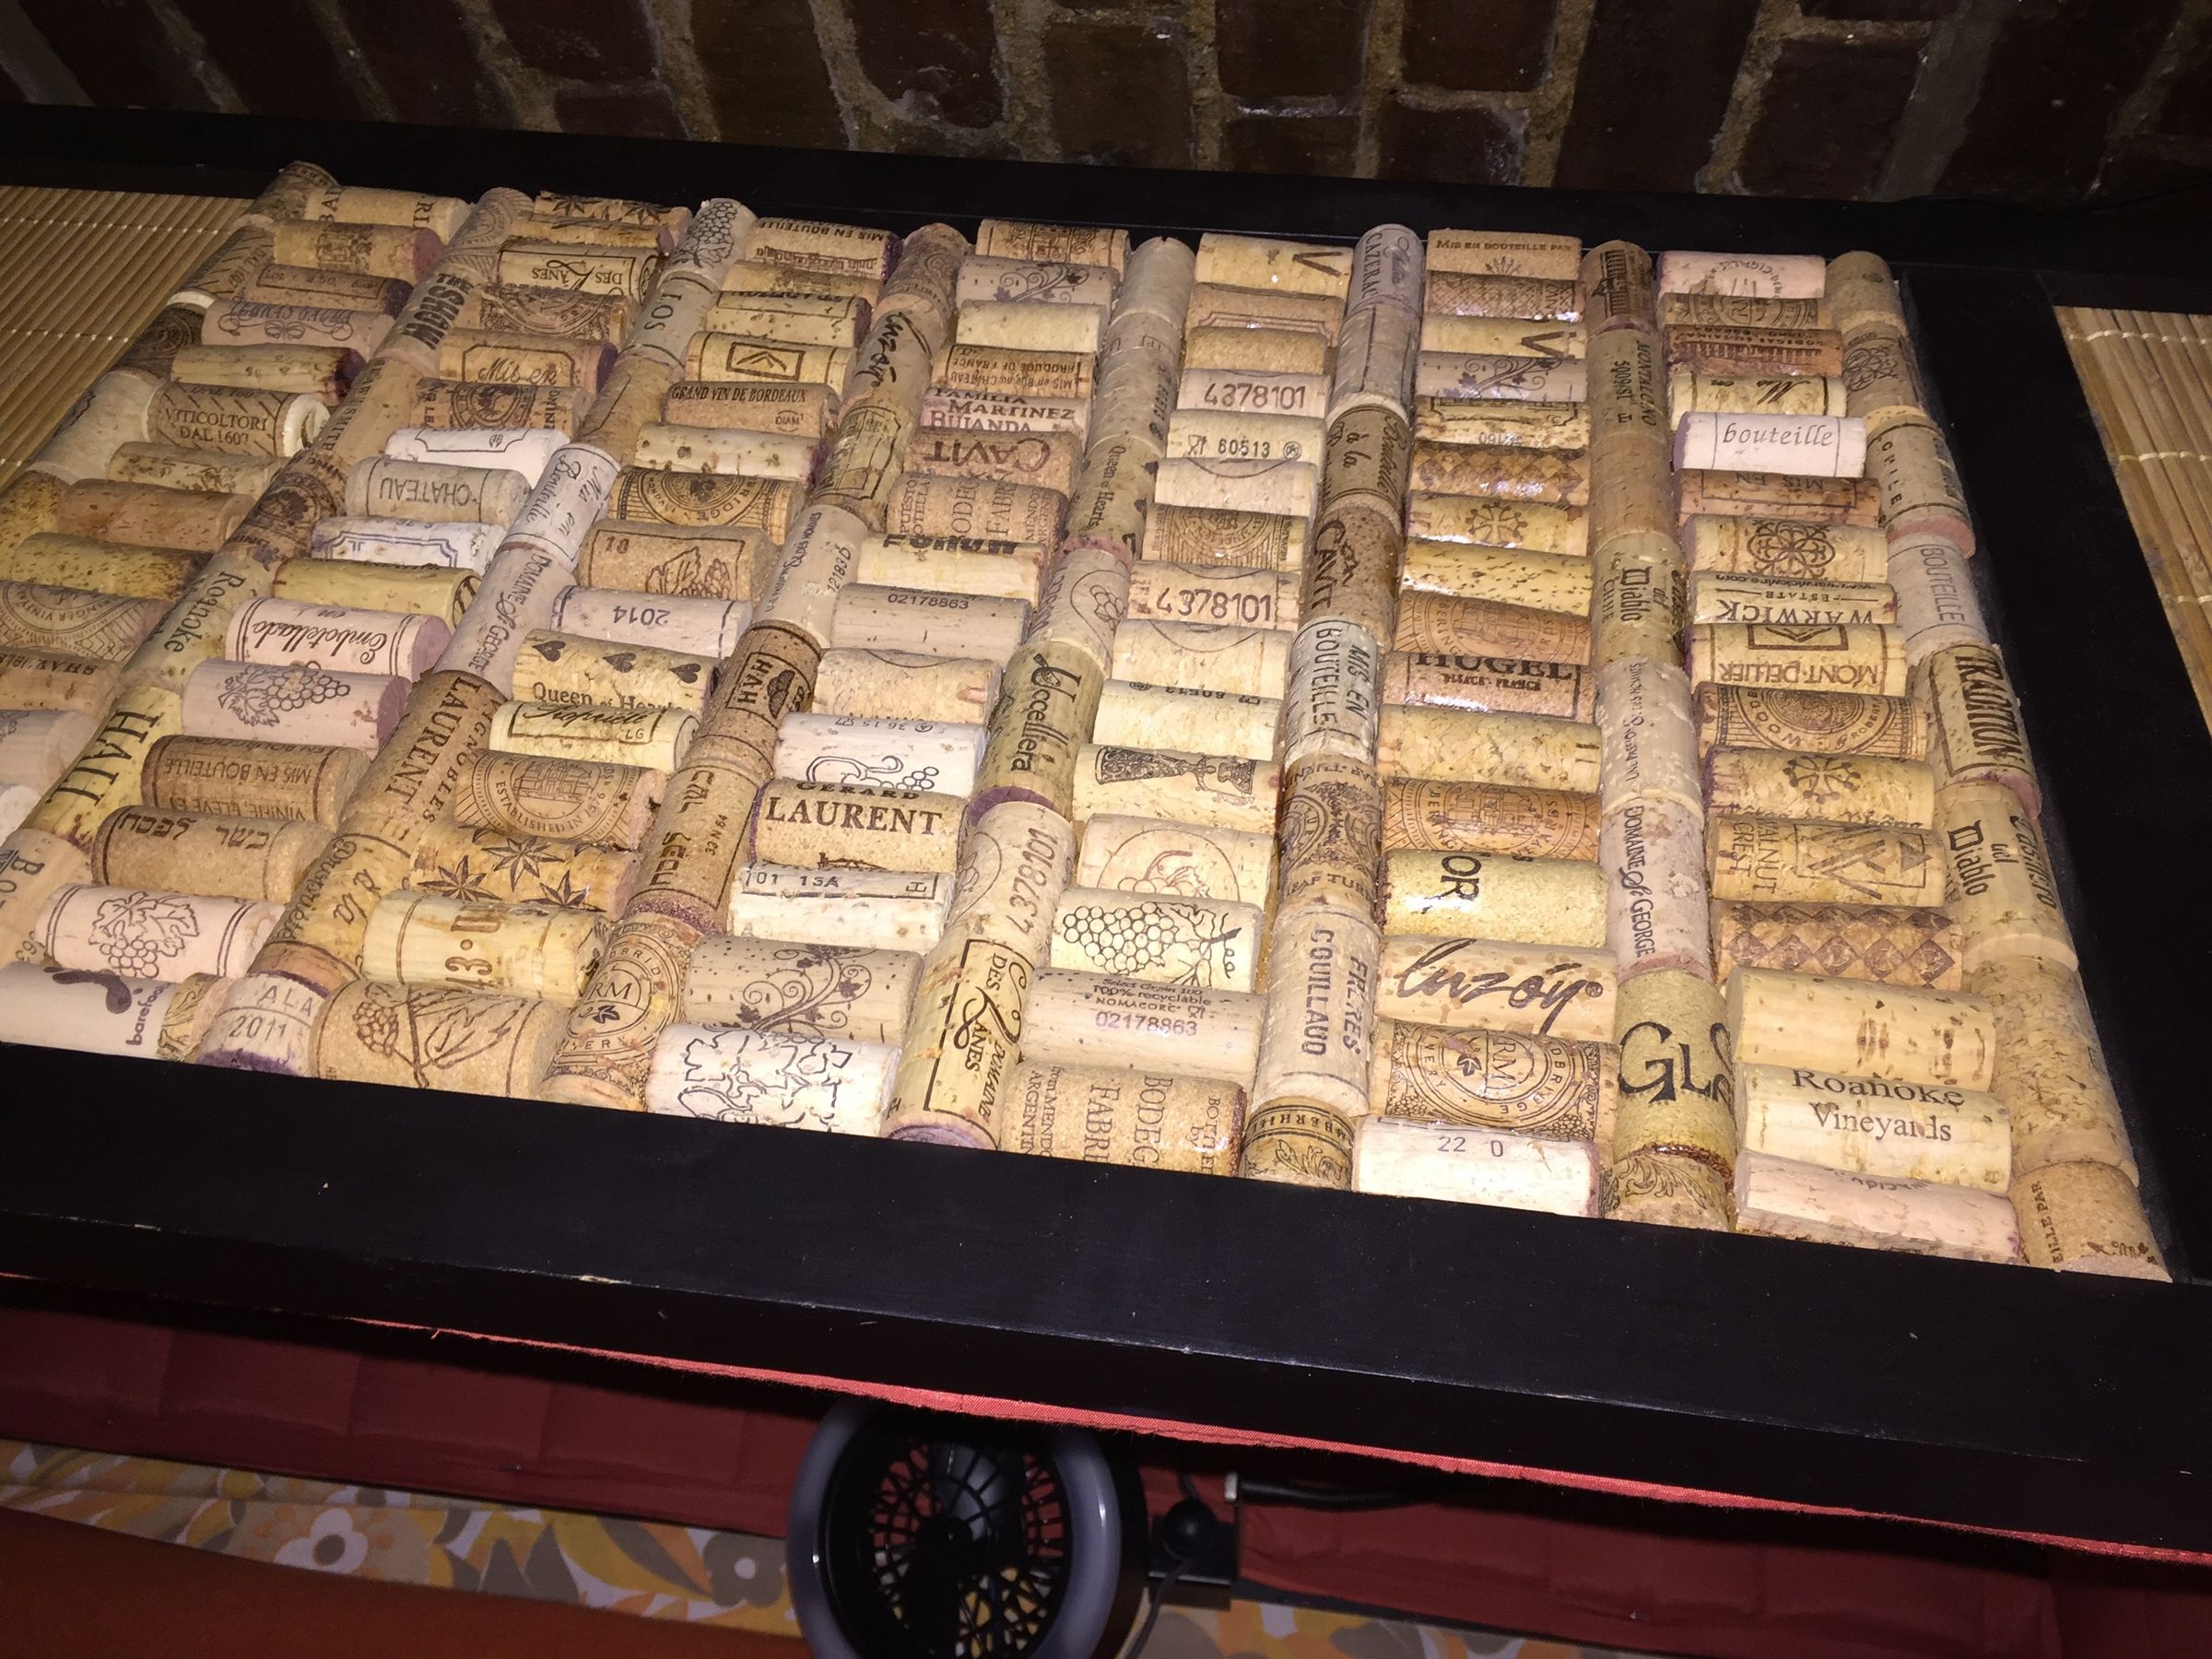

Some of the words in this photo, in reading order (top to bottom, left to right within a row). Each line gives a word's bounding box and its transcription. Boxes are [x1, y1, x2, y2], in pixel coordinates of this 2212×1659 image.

[948, 400, 1077, 420] MARTINEZ
[1204, 385, 1307, 411] 4378101
[1722, 422, 1834, 447] bouteille
[1155, 587, 1273, 624] 4378101
[532, 683, 593, 709] Queen
[764, 796, 944, 836] LAURENT
[1791, 1068, 1966, 1112] Roanoke
[1807, 1100, 1953, 1143] Vineyards
[1437, 1135, 1467, 1153] 22
